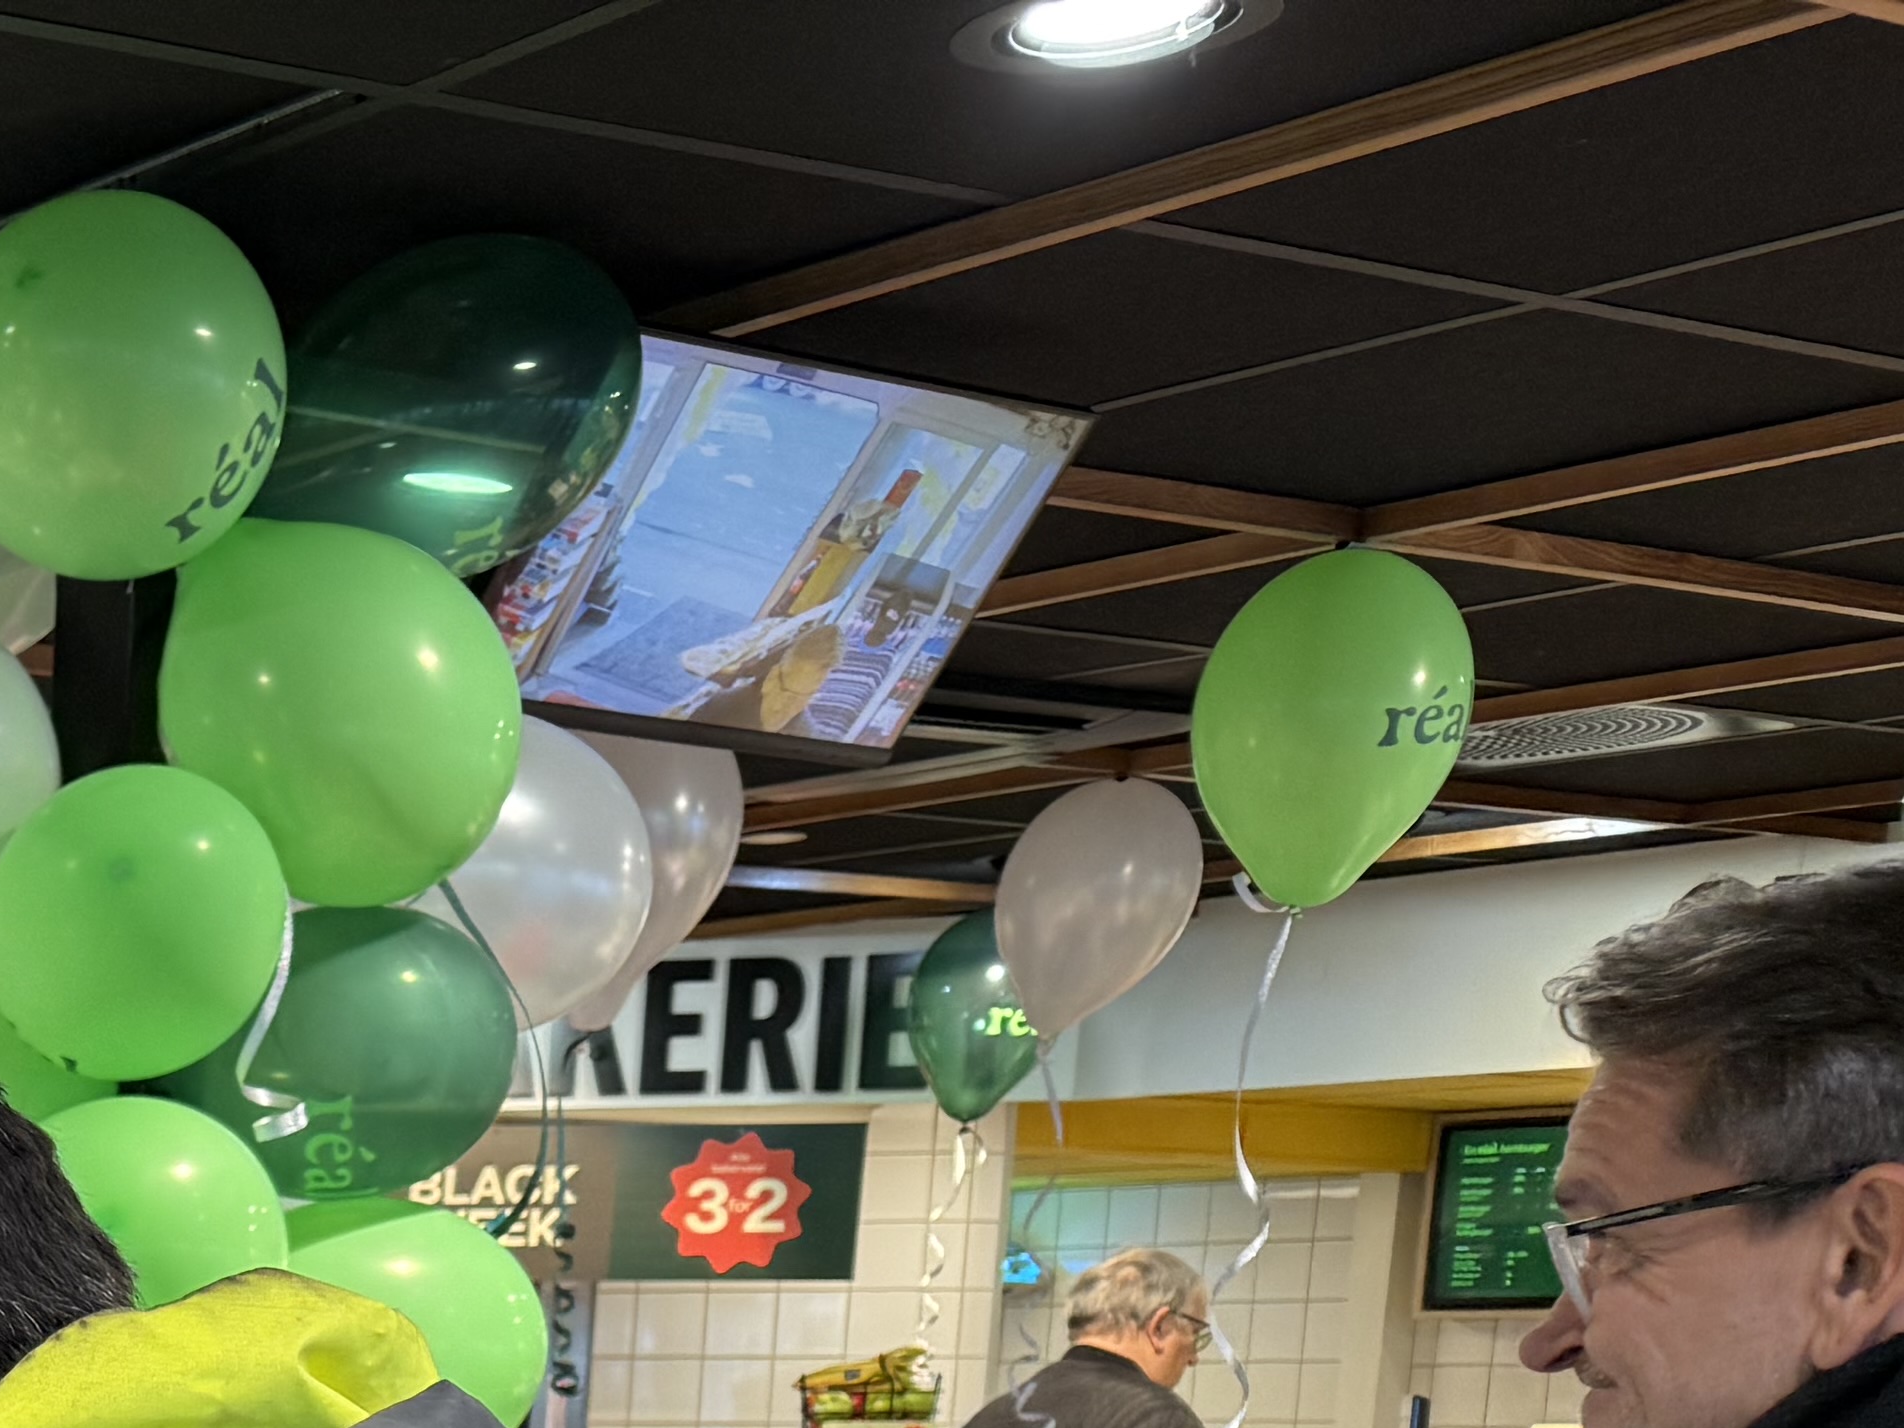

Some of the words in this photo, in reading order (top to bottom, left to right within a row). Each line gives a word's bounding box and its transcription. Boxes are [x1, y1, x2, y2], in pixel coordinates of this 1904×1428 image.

[165, 358, 284, 543] réal
[1378, 682, 1475, 746] réa
[408, 1163, 580, 1206] BLACK
[684, 1178, 729, 1234] 3
[729, 1196, 752, 1214] for
[743, 1178, 788, 1234] 2
